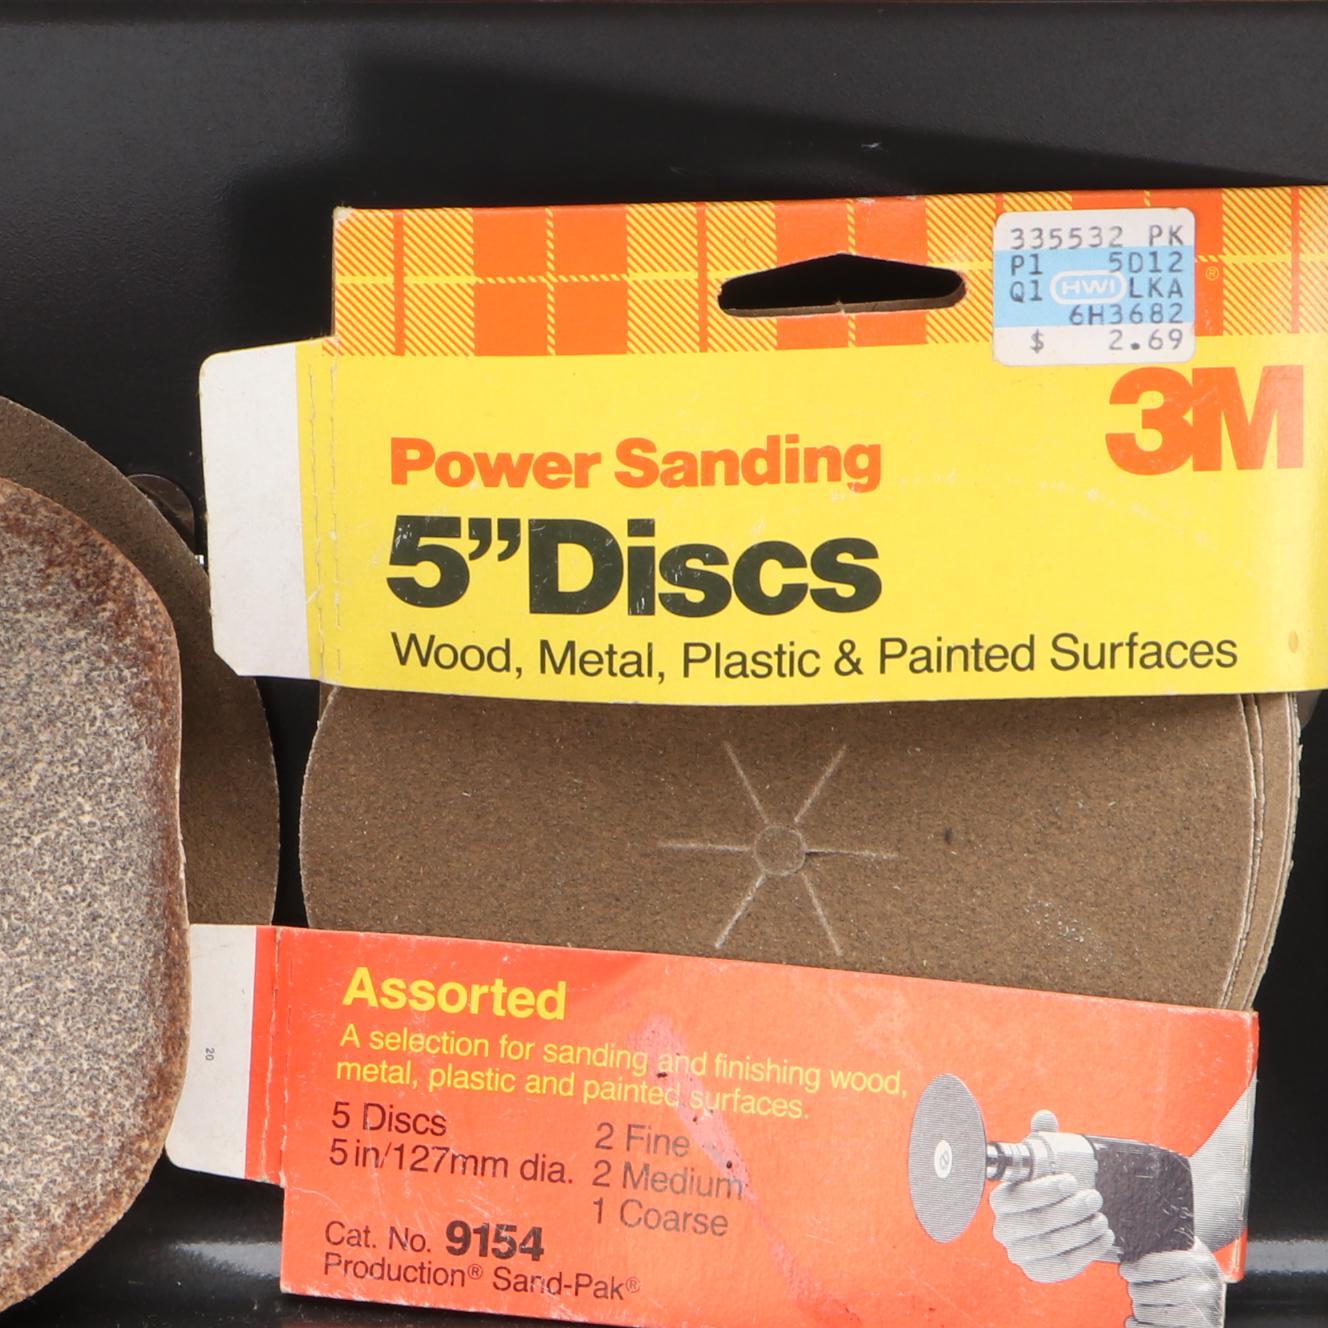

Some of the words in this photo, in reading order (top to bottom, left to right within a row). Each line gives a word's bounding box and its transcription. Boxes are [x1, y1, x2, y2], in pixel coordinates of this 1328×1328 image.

[1010, 226, 1124, 250] 335532
[1148, 225, 1185, 247] PK
[1011, 254, 1044, 276] P1
[1010, 281, 1044, 302] Q1
[1129, 277, 1184, 299] LKA
[1060, 275, 1117, 295] HWI
[1069, 303, 1184, 326] 6H3682
[1031, 329, 1045, 354] $
[1109, 329, 1184, 351] 2.69
[1105, 365, 1305, 476] 3M
[390, 437, 602, 490] Power
[614, 433, 882, 493] Sanding
[390, 631, 523, 680] Wood,
[539, 639, 666, 684] Metal,
[682, 640, 822, 680] Plastic
[833, 639, 865, 676] &
[879, 634, 1036, 675] Painted
[1050, 632, 1239, 671] Surfaces
[342, 966, 567, 1021] Assorted
[339, 1024, 360, 1048] A
[369, 1027, 489, 1057] selection
[499, 1034, 535, 1061] for
[543, 1041, 649, 1077] sanding
[657, 1051, 708, 1076] and
[714, 1053, 822, 1095] finishing
[829, 1068, 908, 1099] wood,
[336, 1059, 419, 1089] metal,
[429, 1064, 516, 1093] plastic
[525, 1072, 575, 1097] and
[583, 1079, 681, 1107] painted
[689, 1088, 809, 1120] surfaces.
[331, 1101, 351, 1129] 5
[362, 1102, 448, 1137] Discs
[594, 1122, 615, 1151] 2
[625, 1123, 690, 1158] Fine
[519, 1153, 574, 1185] dia.
[592, 1159, 611, 1188] 2
[622, 1160, 744, 1201] Medium
[592, 1197, 604, 1225] 1
[619, 1198, 729, 1237] Coarse
[324, 1220, 377, 1249] Cat.
[388, 1226, 431, 1253] No.
[445, 1219, 545, 1262] 9154
